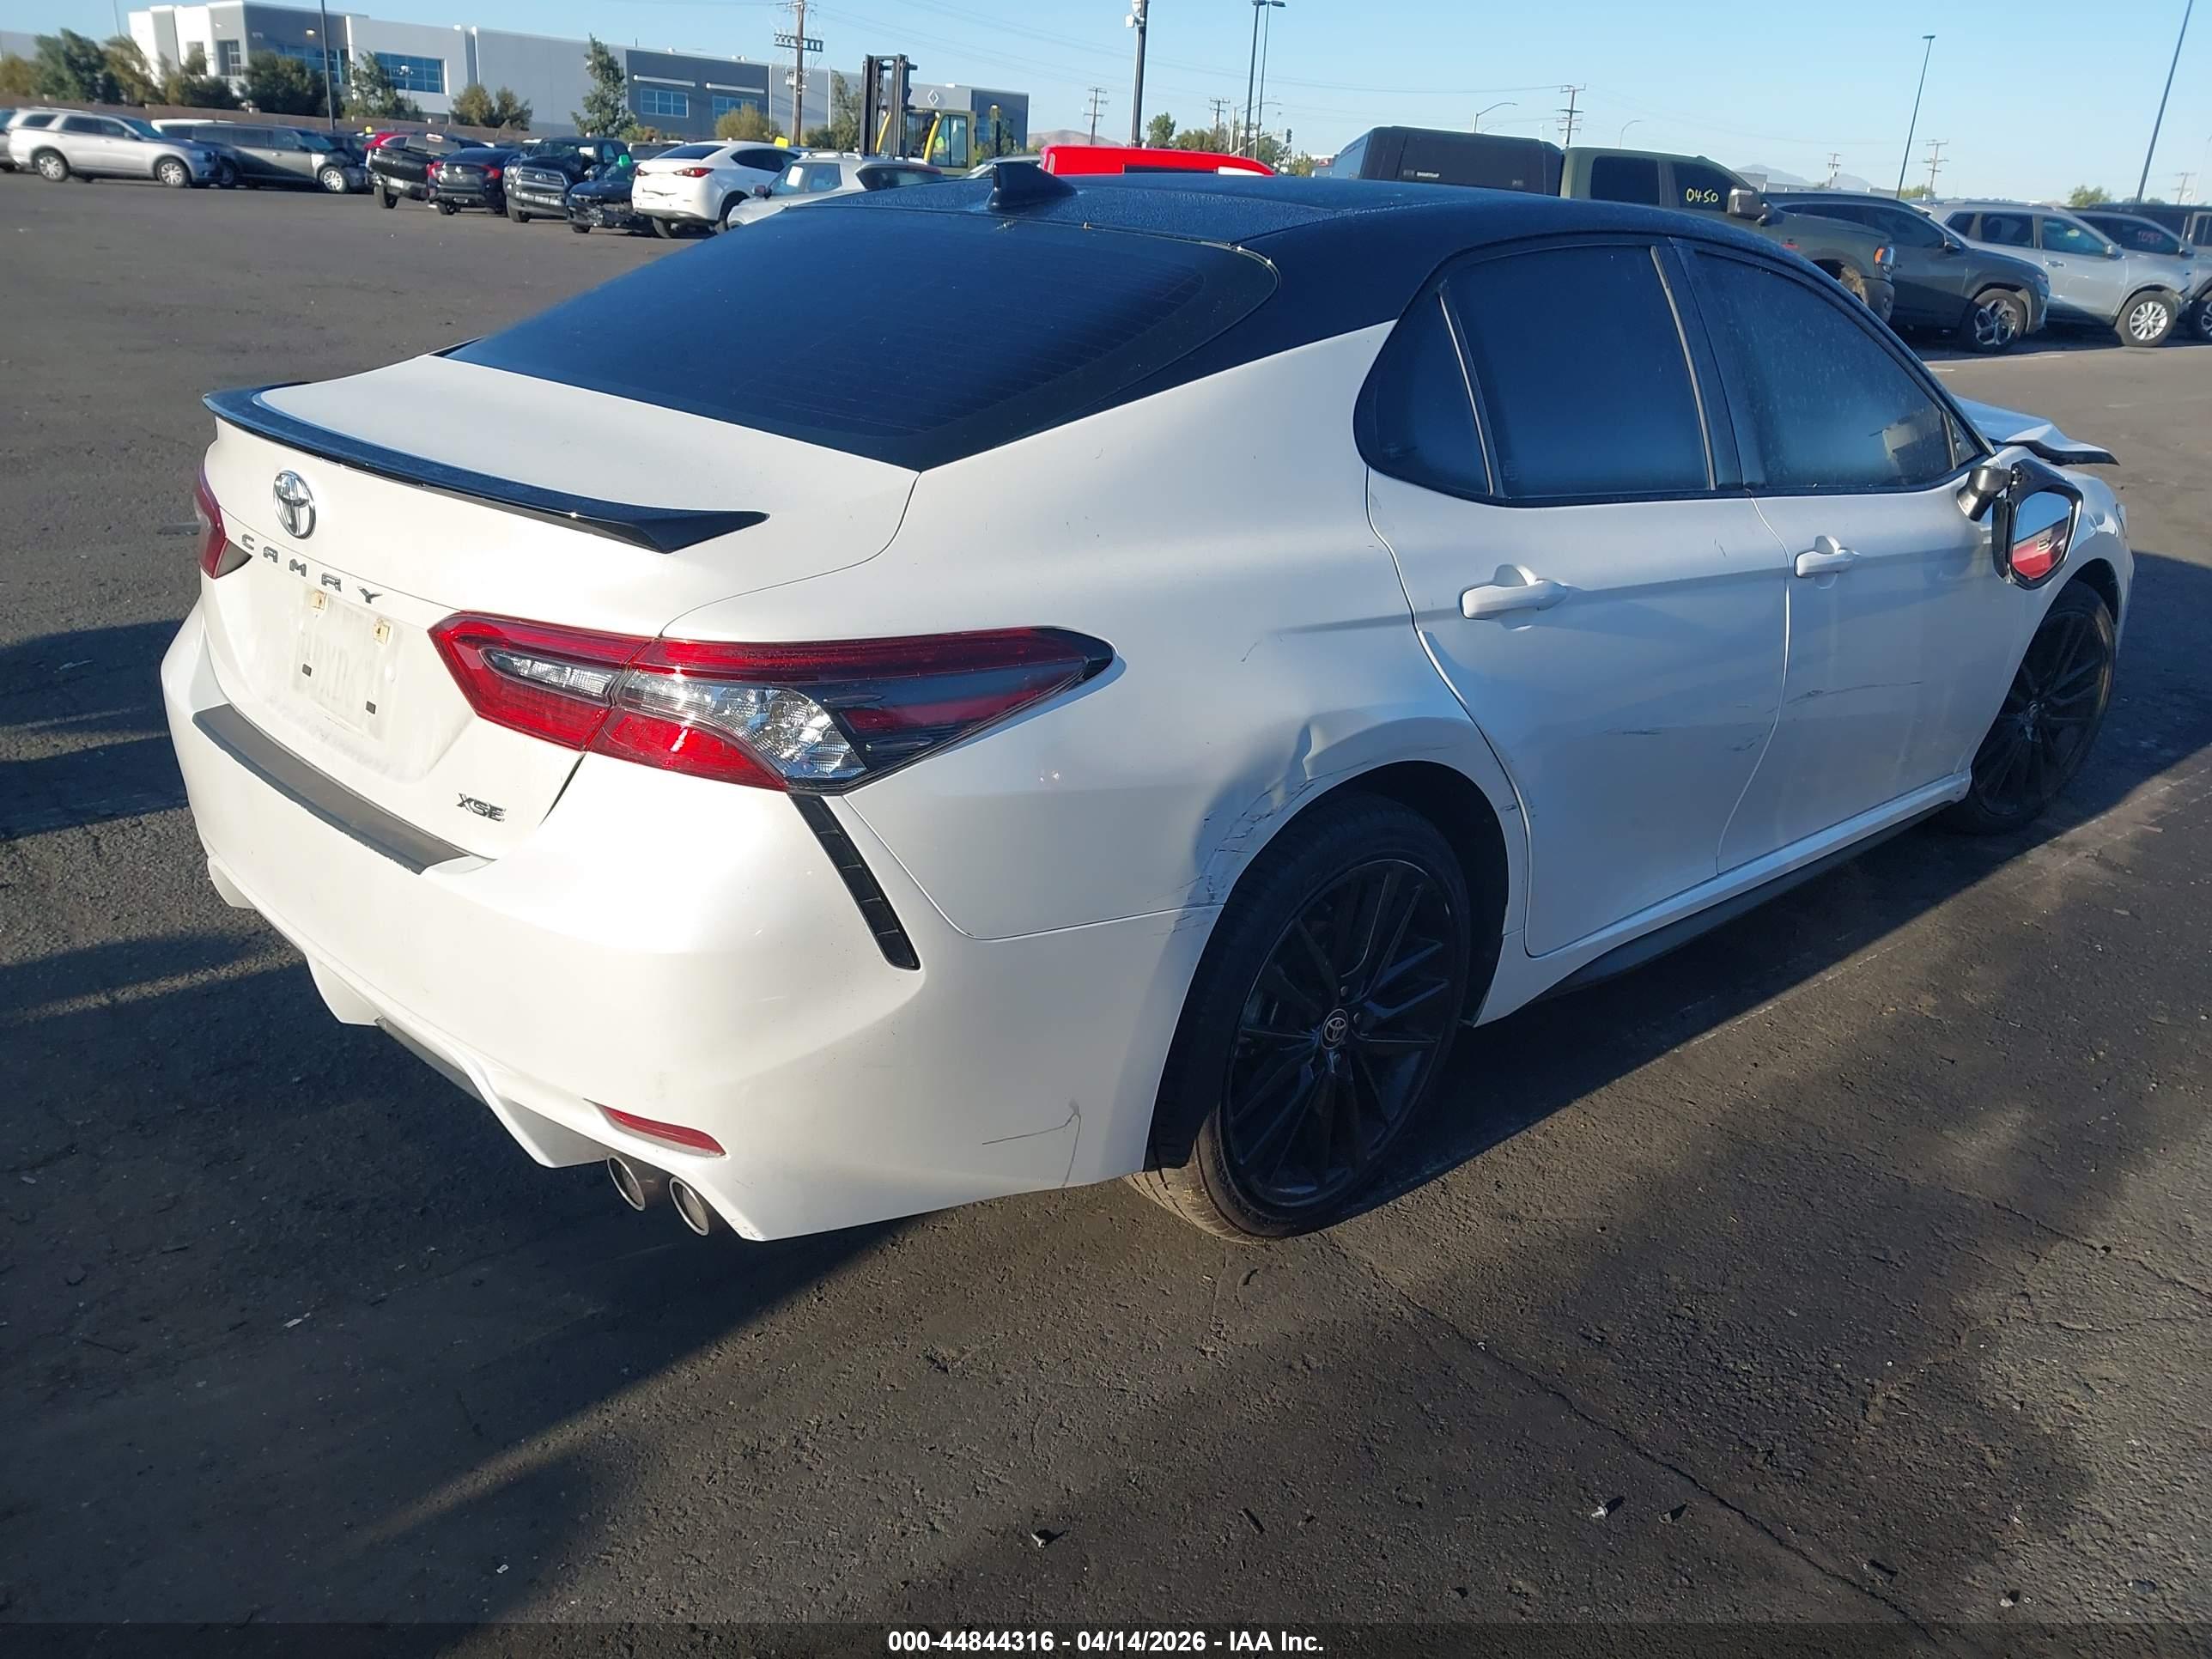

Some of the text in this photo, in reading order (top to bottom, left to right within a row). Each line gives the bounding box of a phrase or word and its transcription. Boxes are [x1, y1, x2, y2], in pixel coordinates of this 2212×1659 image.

[1686, 187, 1719, 204] 0450
[241, 533, 384, 605] CAMRY
[456, 793, 505, 822] XSE
